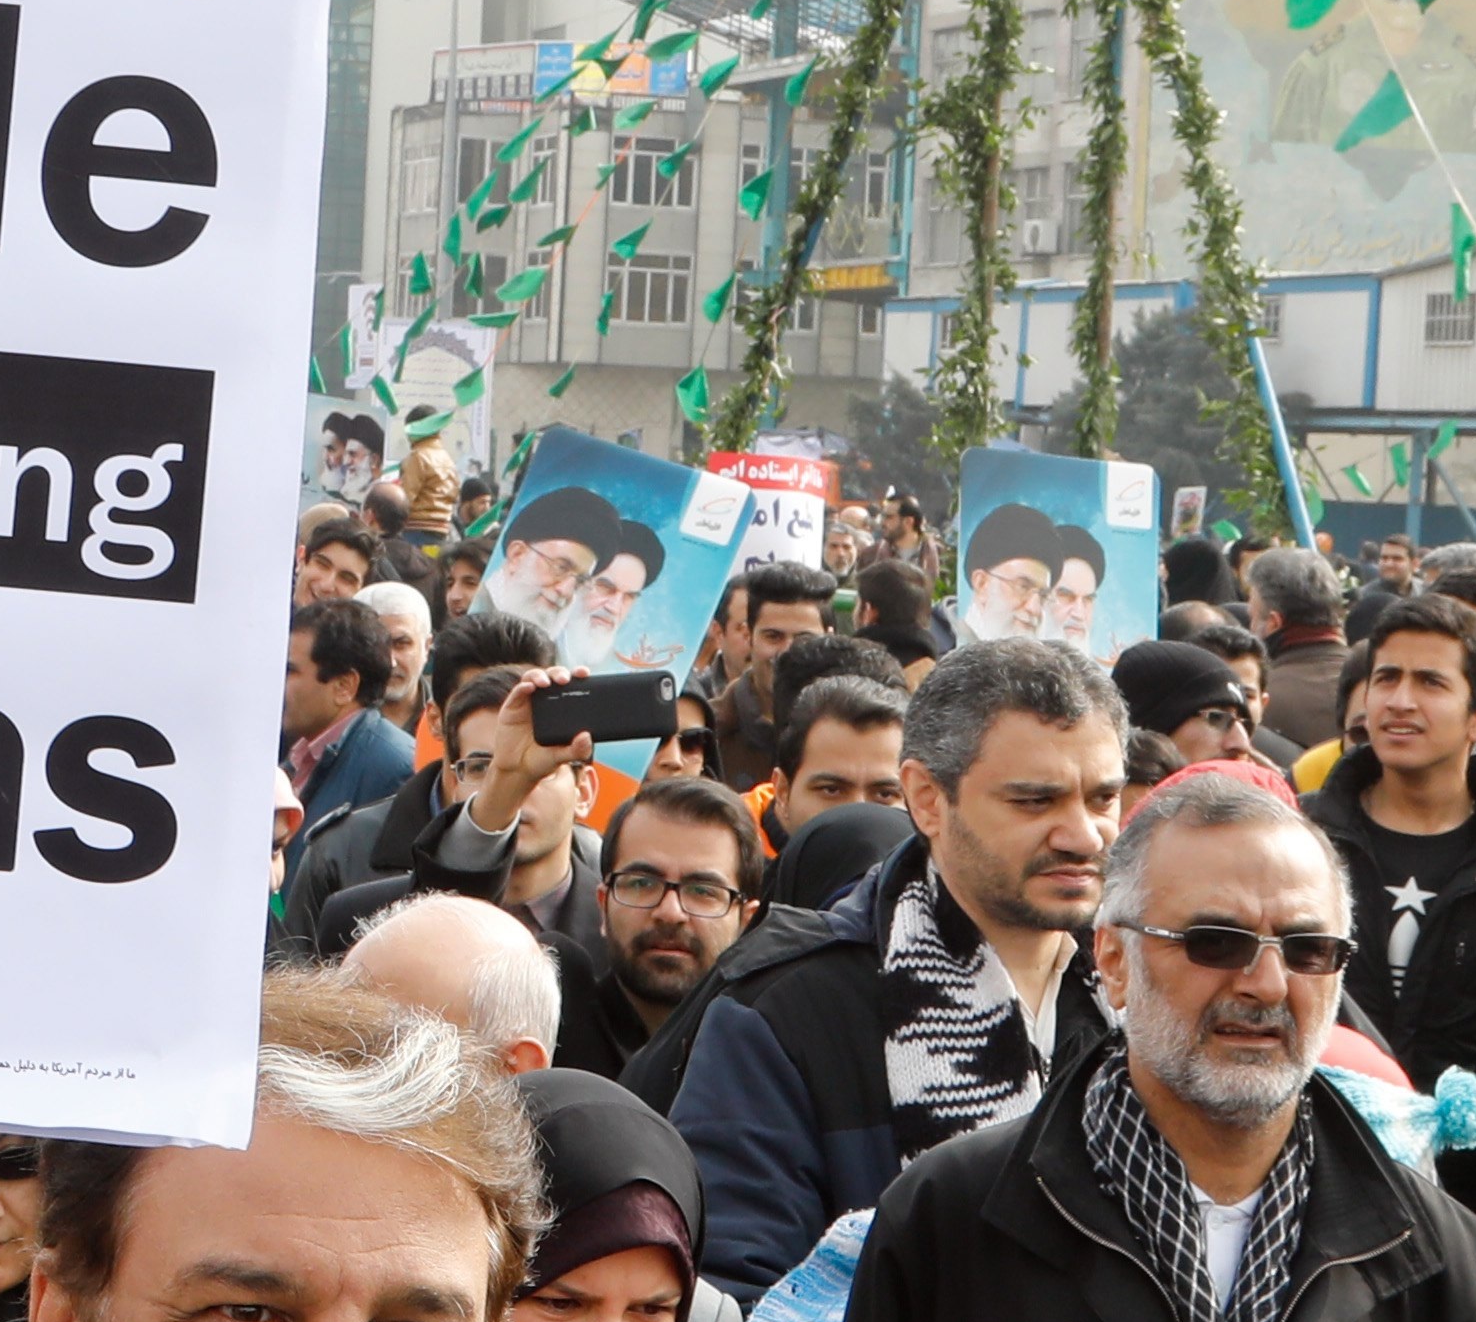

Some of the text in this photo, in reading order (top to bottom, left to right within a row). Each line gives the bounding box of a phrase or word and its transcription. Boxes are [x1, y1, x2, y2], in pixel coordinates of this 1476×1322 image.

[13, 1059, 36, 1073] دلیل
[38, 1062, 49, 1073] به
[51, 1061, 83, 1076] آمریکا
[84, 1067, 112, 1080] مردم
